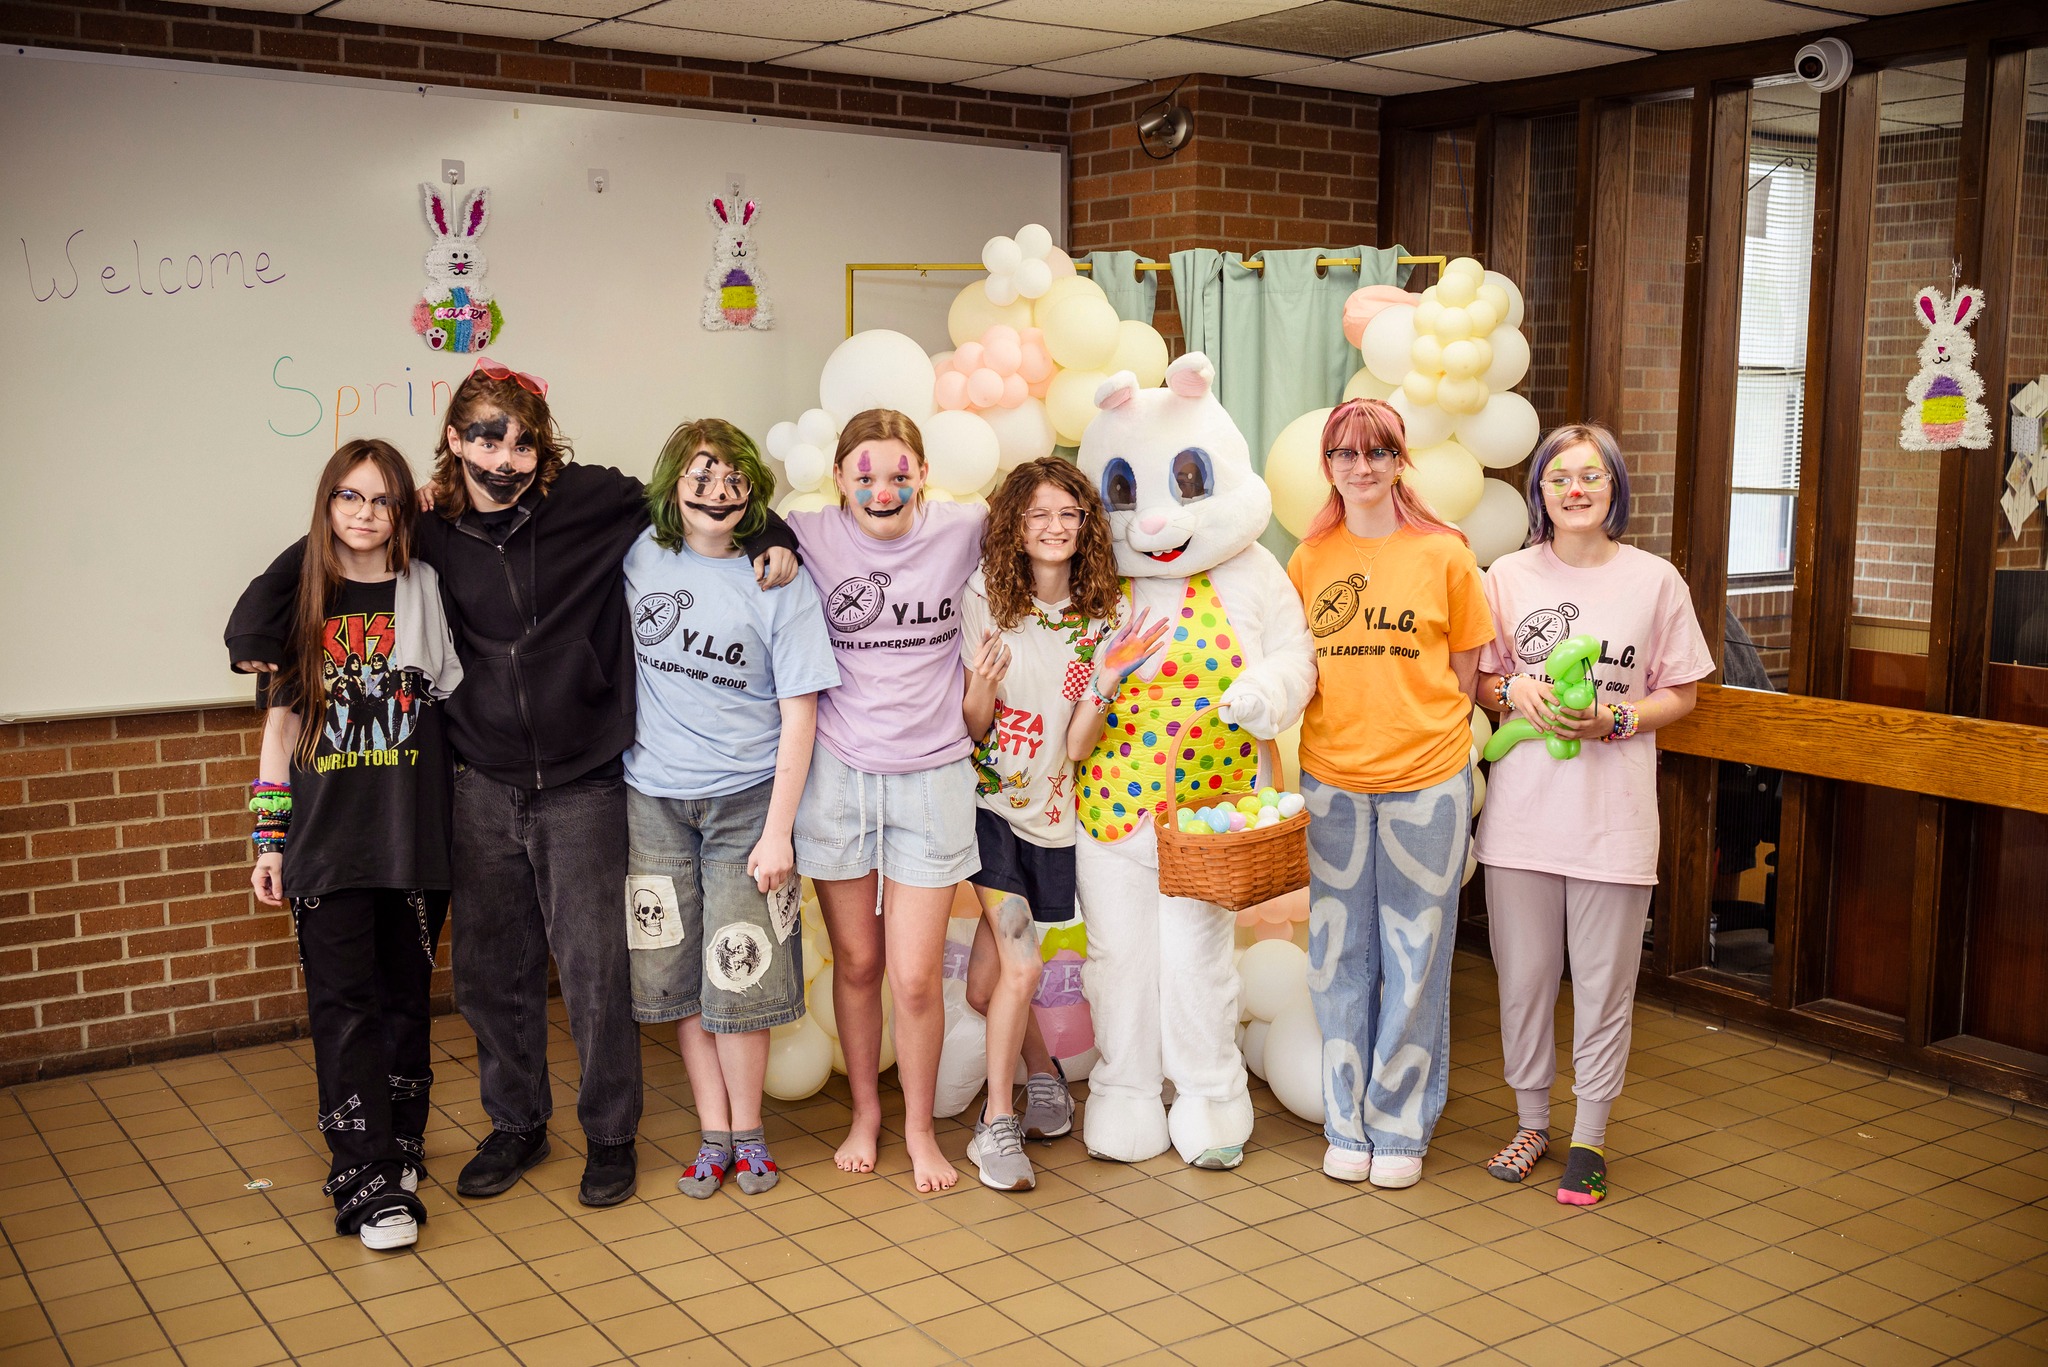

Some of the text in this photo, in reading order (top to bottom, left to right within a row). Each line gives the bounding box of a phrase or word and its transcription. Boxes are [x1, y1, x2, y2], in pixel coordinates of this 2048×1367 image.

[20, 229, 286, 302] Welcome
[268, 355, 452, 451] Sprin
[892, 598, 955, 626] Y.L.G.
[1364, 606, 1418, 634] Y.L.G.
[323, 612, 395, 667] KIS
[682, 628, 747, 667] Y.L.G.
[858, 637, 926, 649] LEADERSHIP
[929, 627, 958, 645] GROUP
[1330, 645, 1386, 656] LEADERSHIP
[1389, 645, 1420, 660] GROUP
[649, 657, 709, 681] LEADERSHIP
[711, 675, 748, 690] GROUP
[1605, 681, 1630, 694] GOUP
[363, 749, 399, 767] TOUR
[404, 749, 419, 766] '7
[999, 729, 1044, 759] RTY
